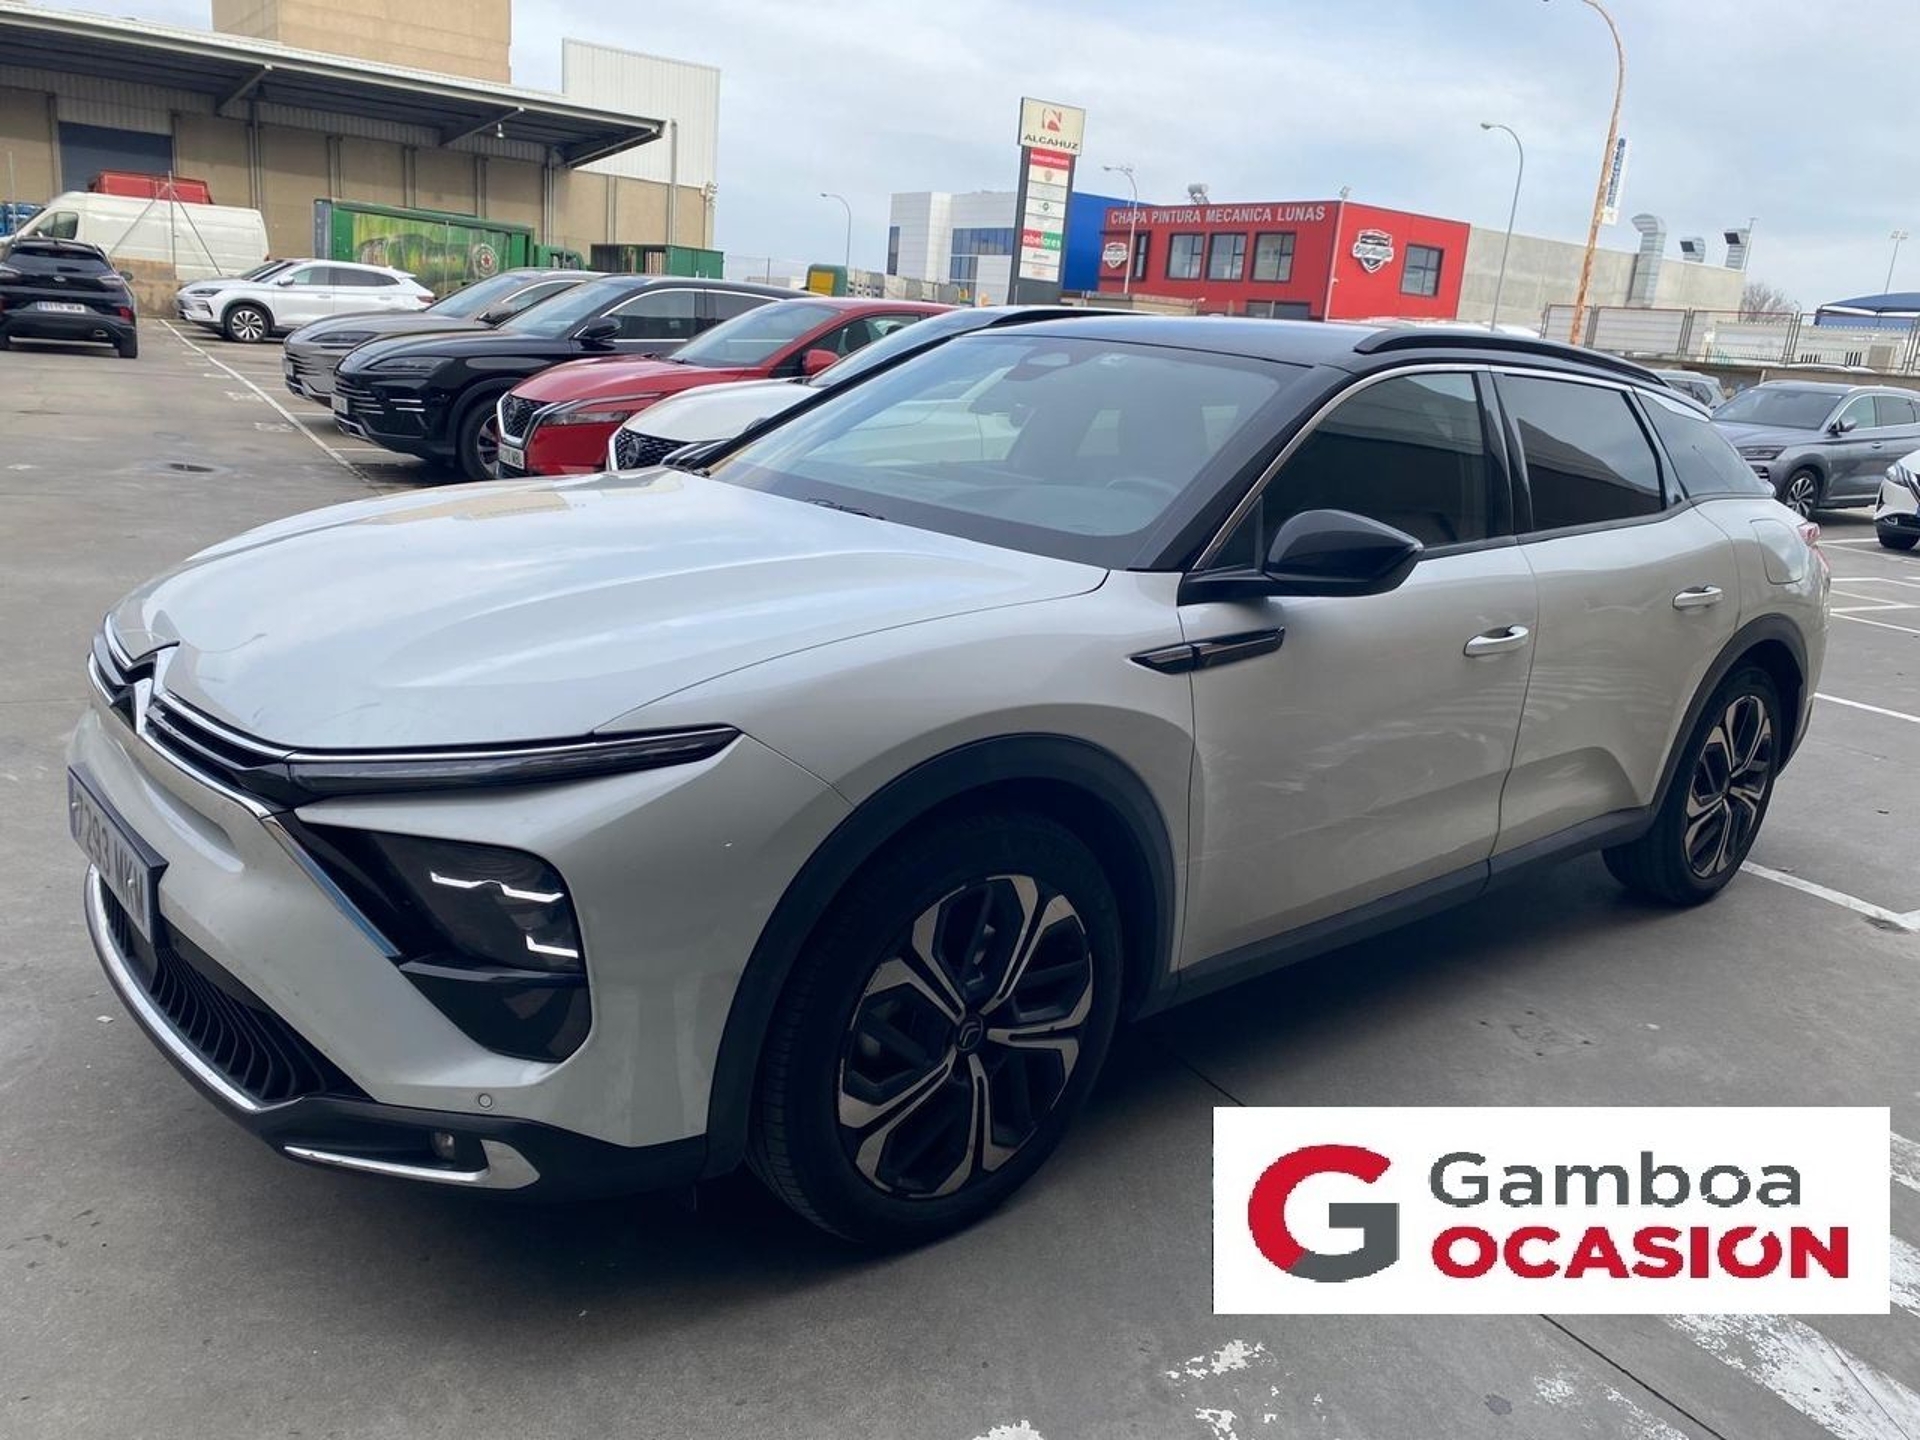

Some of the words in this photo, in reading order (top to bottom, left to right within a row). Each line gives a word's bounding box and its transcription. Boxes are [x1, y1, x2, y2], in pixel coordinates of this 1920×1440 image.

[1023, 132, 1079, 150] ALCAHUZ
[1110, 210, 1147, 224] CHAPA
[1151, 209, 1201, 224] PINTURA
[1205, 207, 1272, 223] MECANICA
[1276, 205, 1326, 222] LUNAS
